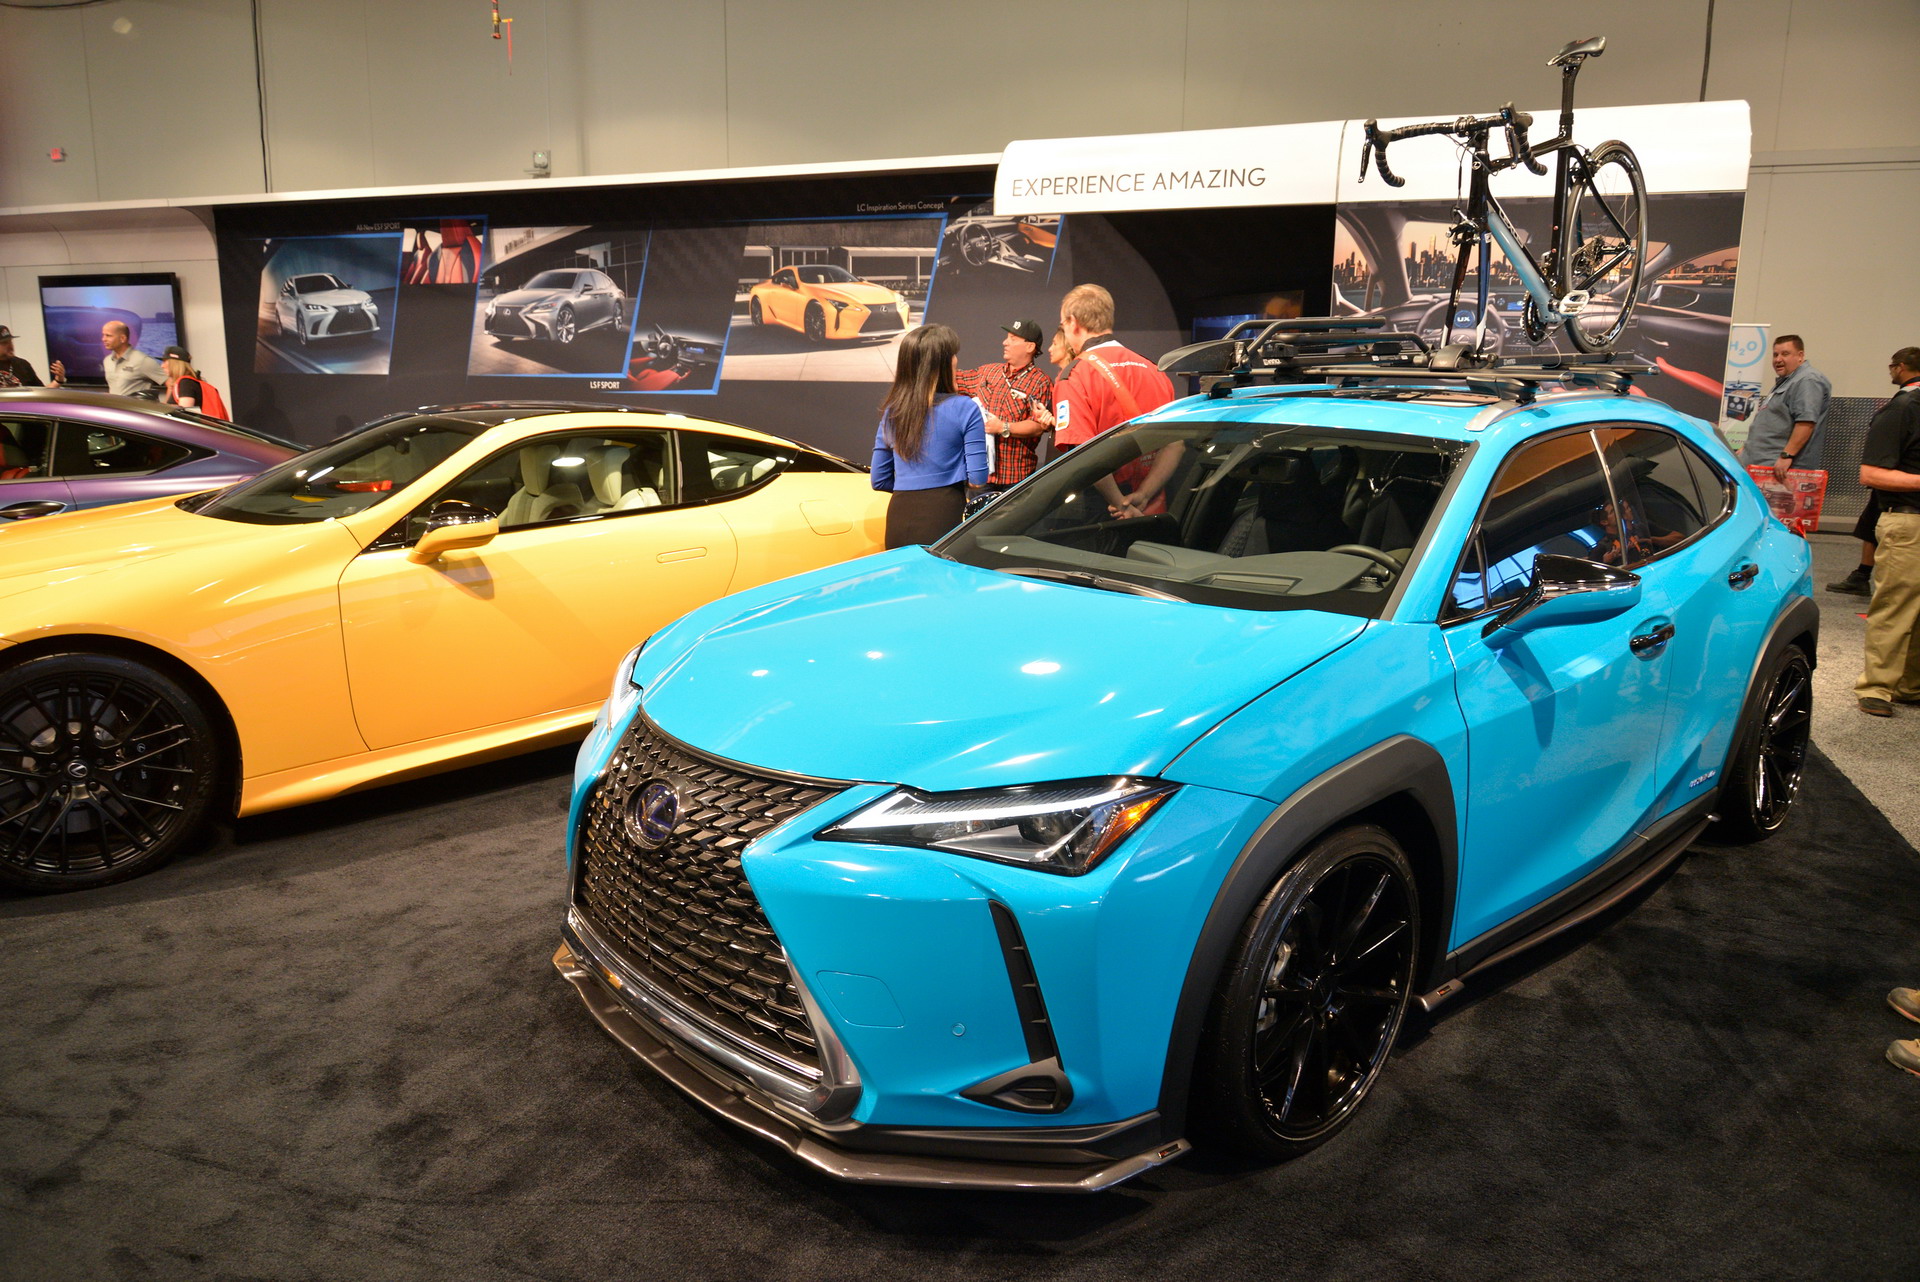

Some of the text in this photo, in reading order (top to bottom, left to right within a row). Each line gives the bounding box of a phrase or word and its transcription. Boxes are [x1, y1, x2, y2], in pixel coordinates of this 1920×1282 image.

[1012, 167, 1266, 197] EXPERIENCE AMAZING
[856, 201, 944, 213] LC Inspiration Series Concept
[590, 380, 597, 389] LS
[601, 381, 620, 389] SPORT
